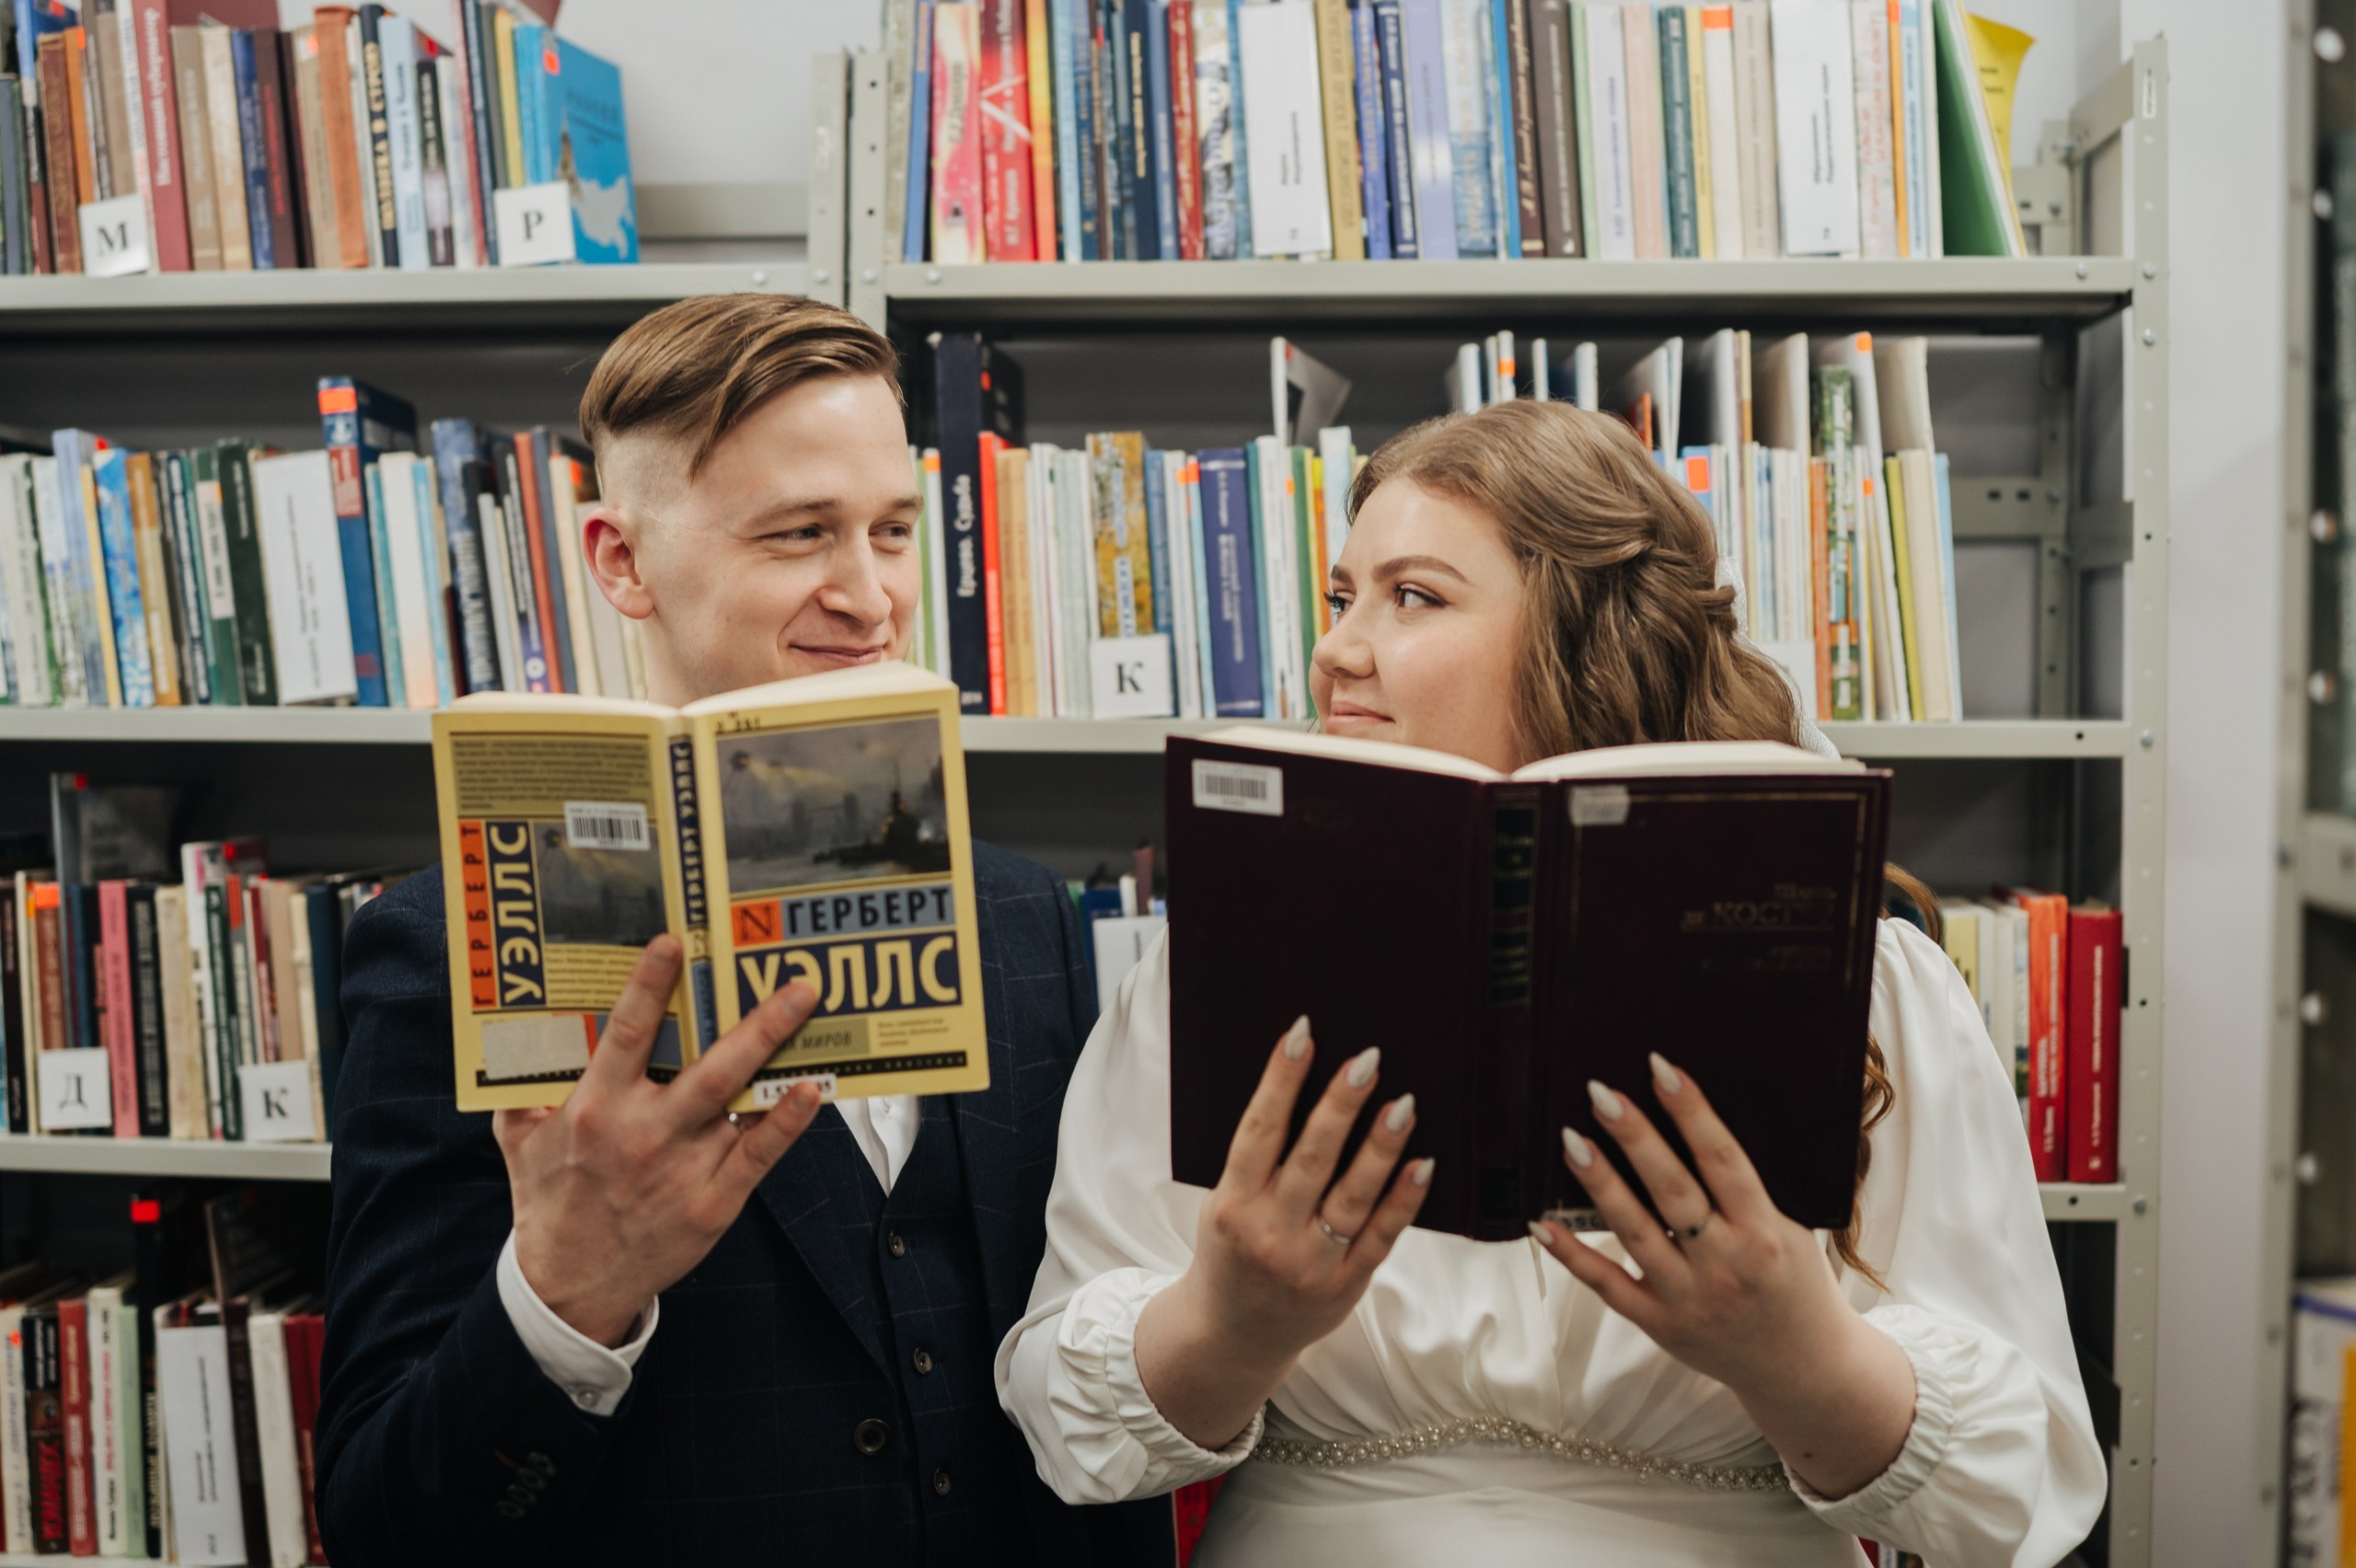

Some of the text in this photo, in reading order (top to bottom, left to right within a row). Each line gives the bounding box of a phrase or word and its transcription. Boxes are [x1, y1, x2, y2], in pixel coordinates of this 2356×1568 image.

[97, 221, 130, 251] М
[522, 210, 544, 240] Р
[1116, 662, 1144, 693] К
[461, 824, 495, 1006] ГЕРБЕРТ
[490, 824, 543, 1004] УЭЛЛС
[787, 888, 949, 936] ГЕРБЕРТ
[739, 935, 959, 1013] УЭЛЛС
[59, 1073, 88, 1110] Д
[263, 1088, 289, 1119] К
